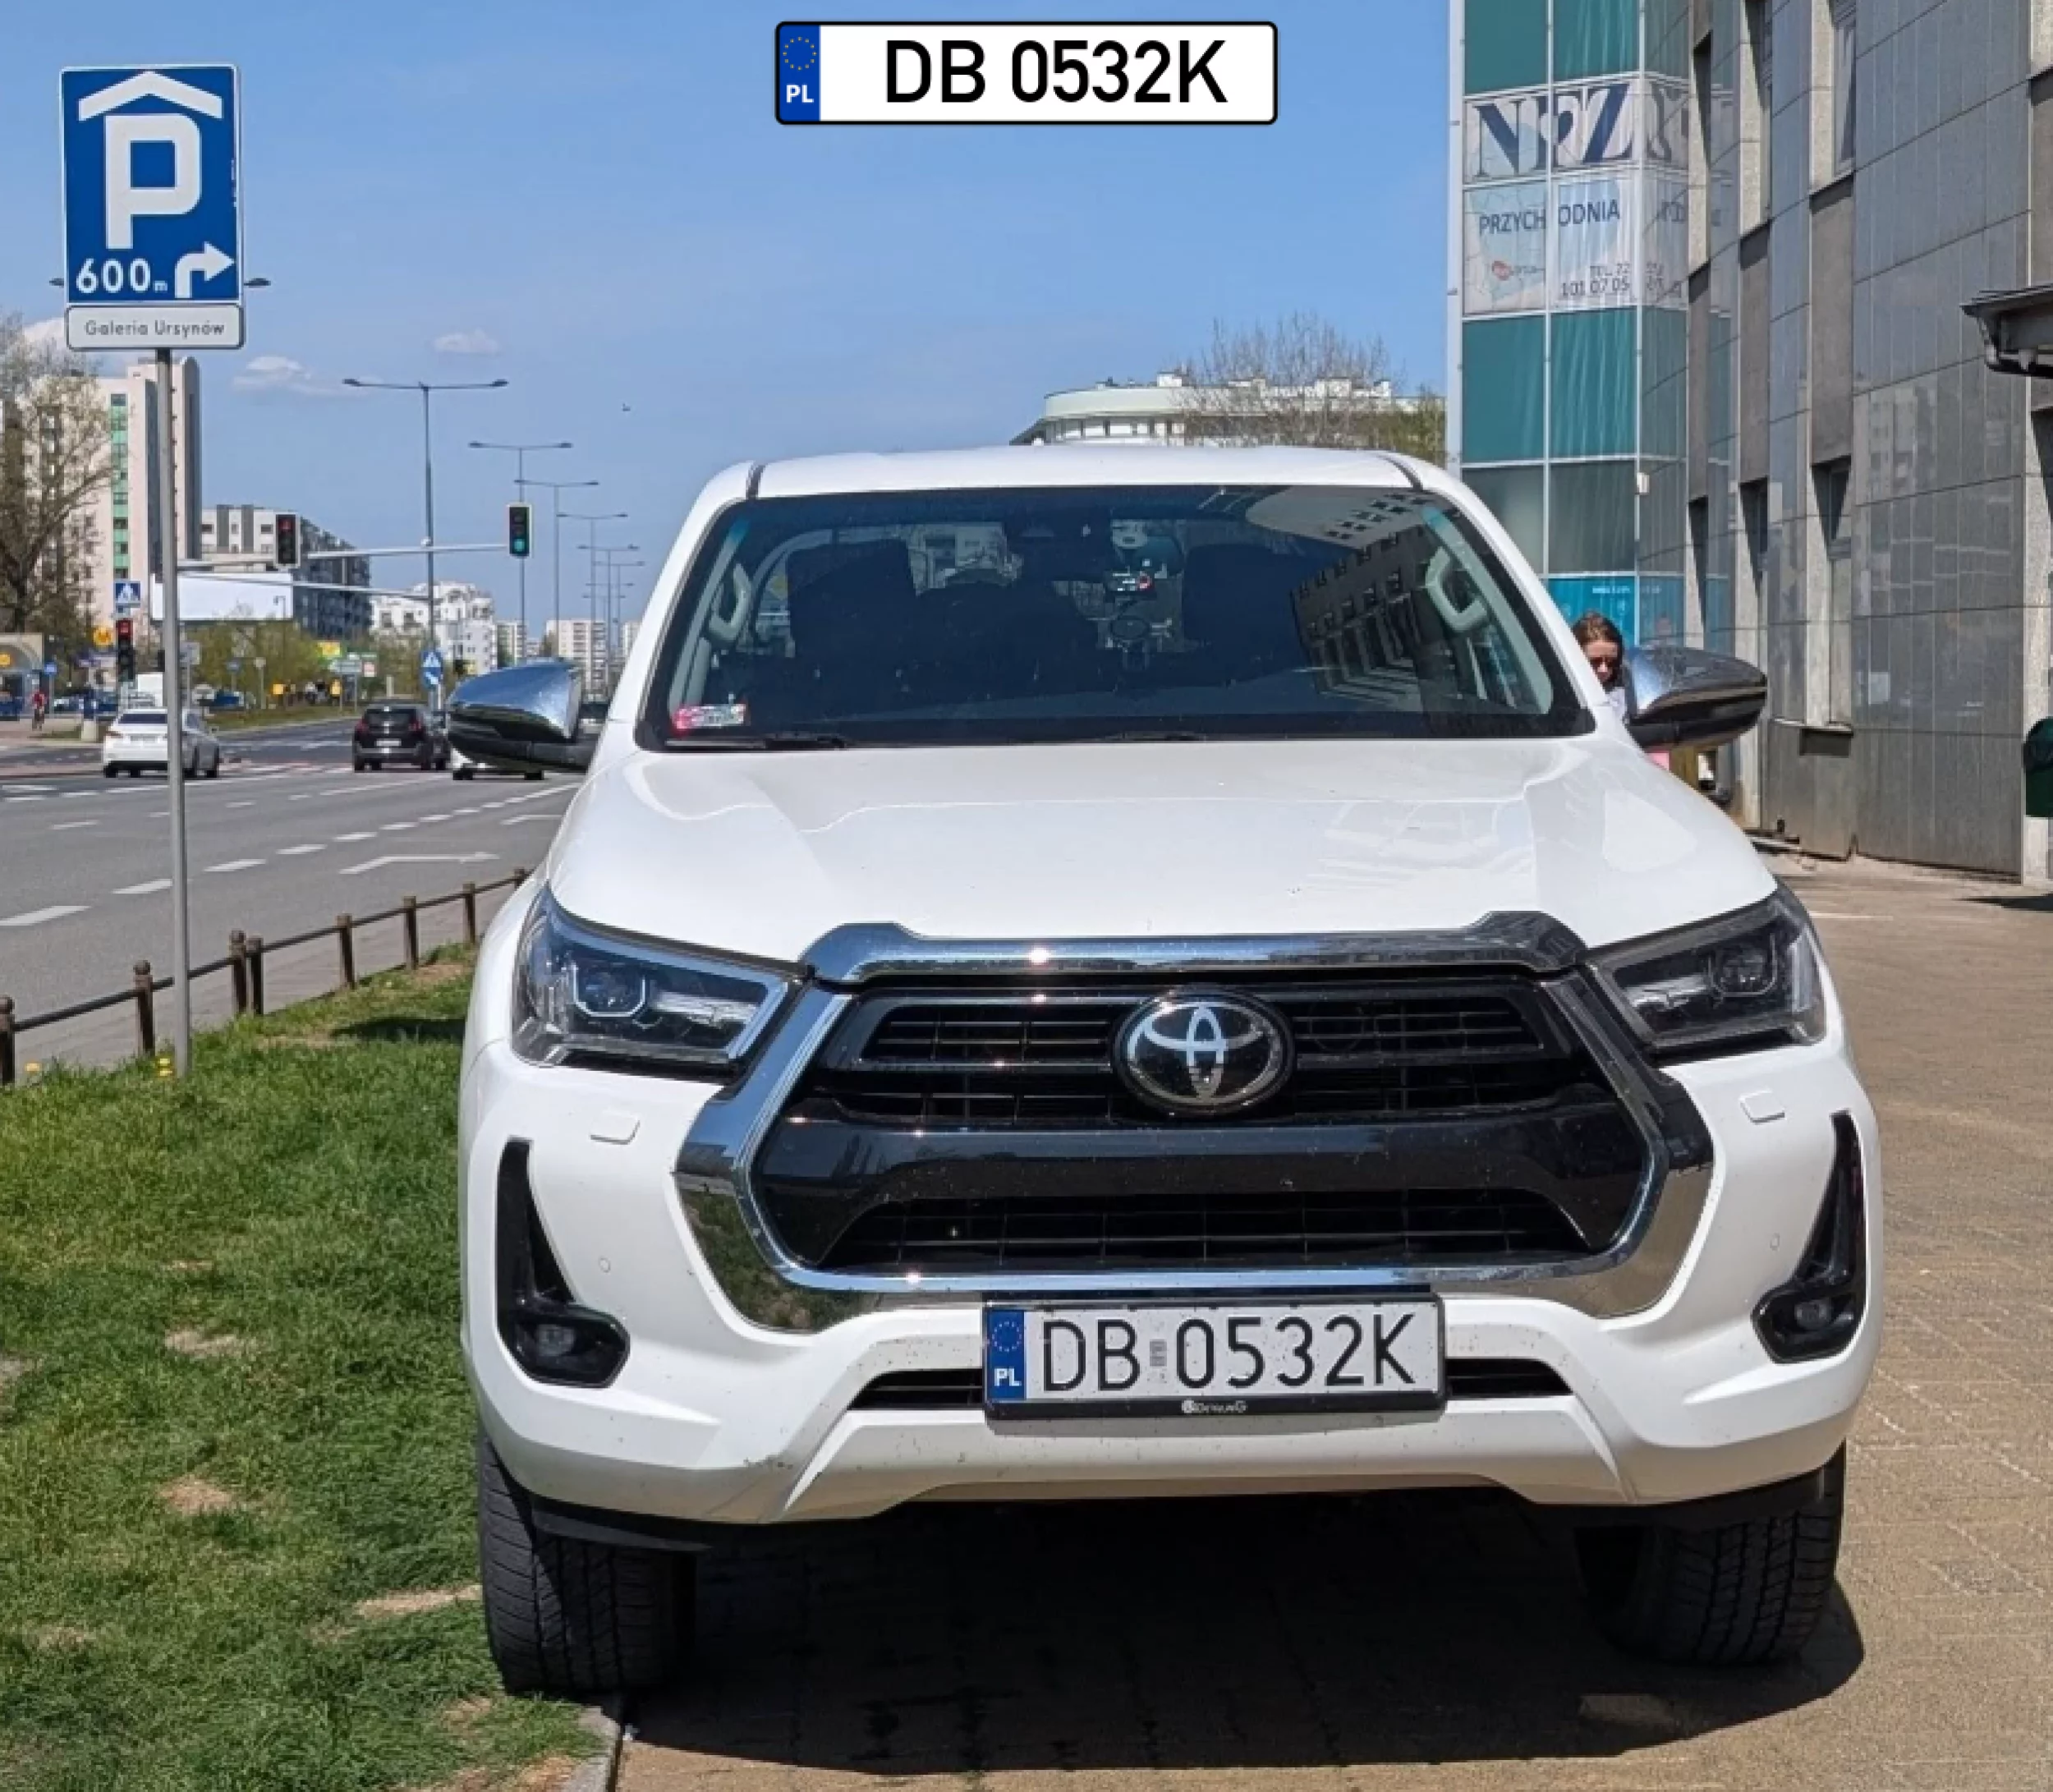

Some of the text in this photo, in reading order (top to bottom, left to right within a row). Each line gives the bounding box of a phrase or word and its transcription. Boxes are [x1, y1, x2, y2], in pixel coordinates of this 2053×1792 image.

[104, 114, 201, 249] P
[85, 319, 225, 338] Galeria Ursynów
[1043, 1313, 1416, 1391] DB 0532K
[994, 1367, 1022, 1387] PL
